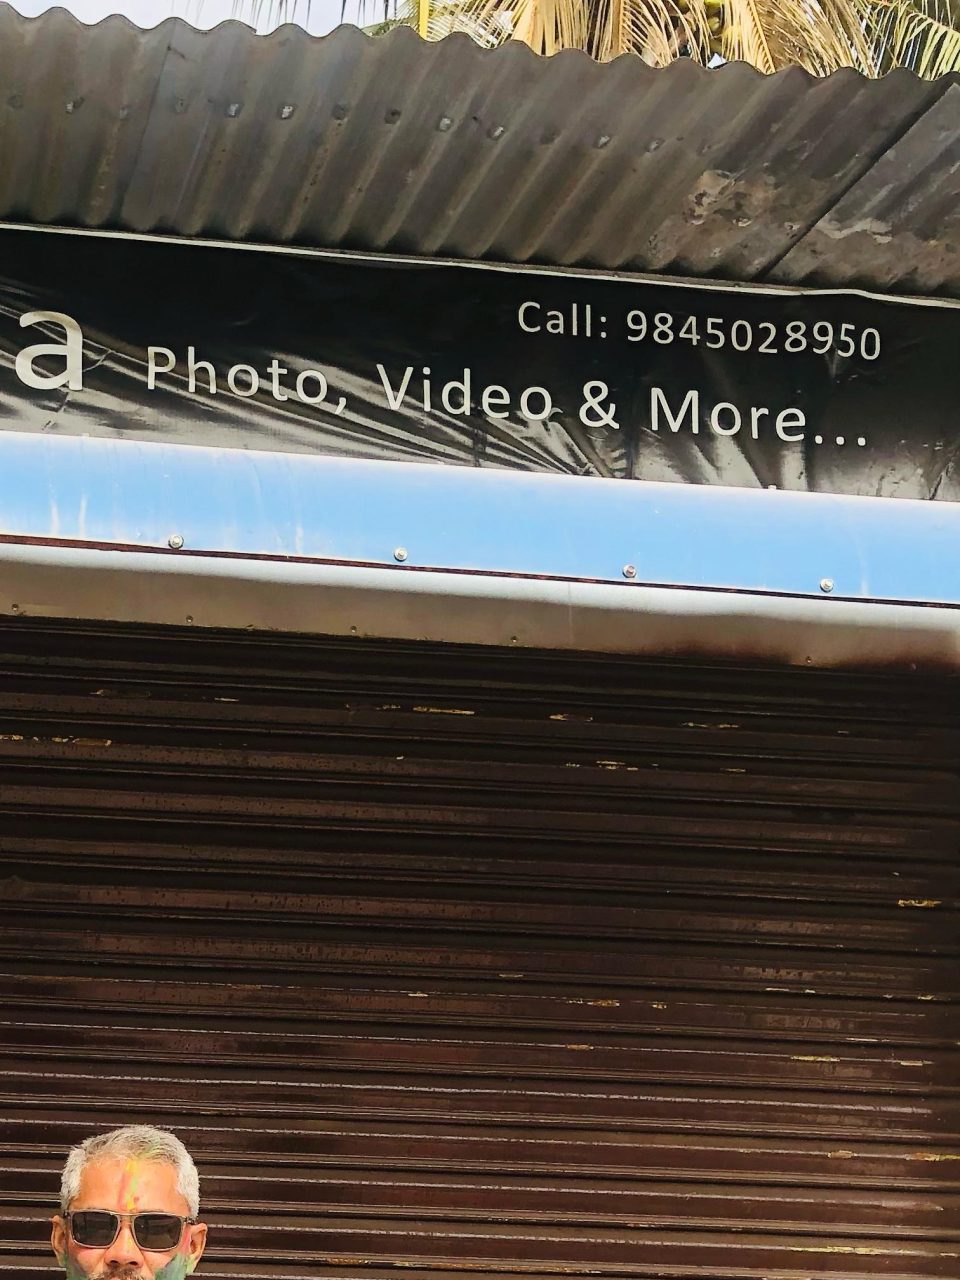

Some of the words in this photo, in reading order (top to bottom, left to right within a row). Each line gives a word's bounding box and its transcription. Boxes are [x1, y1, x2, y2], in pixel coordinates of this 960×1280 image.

[518, 301, 608, 339] Call:
[626, 310, 881, 361] 9845028950
[147, 346, 347, 415] Photo,
[376, 364, 554, 422] Video
[579, 380, 620, 430] &
[651, 387, 868, 447] More...
